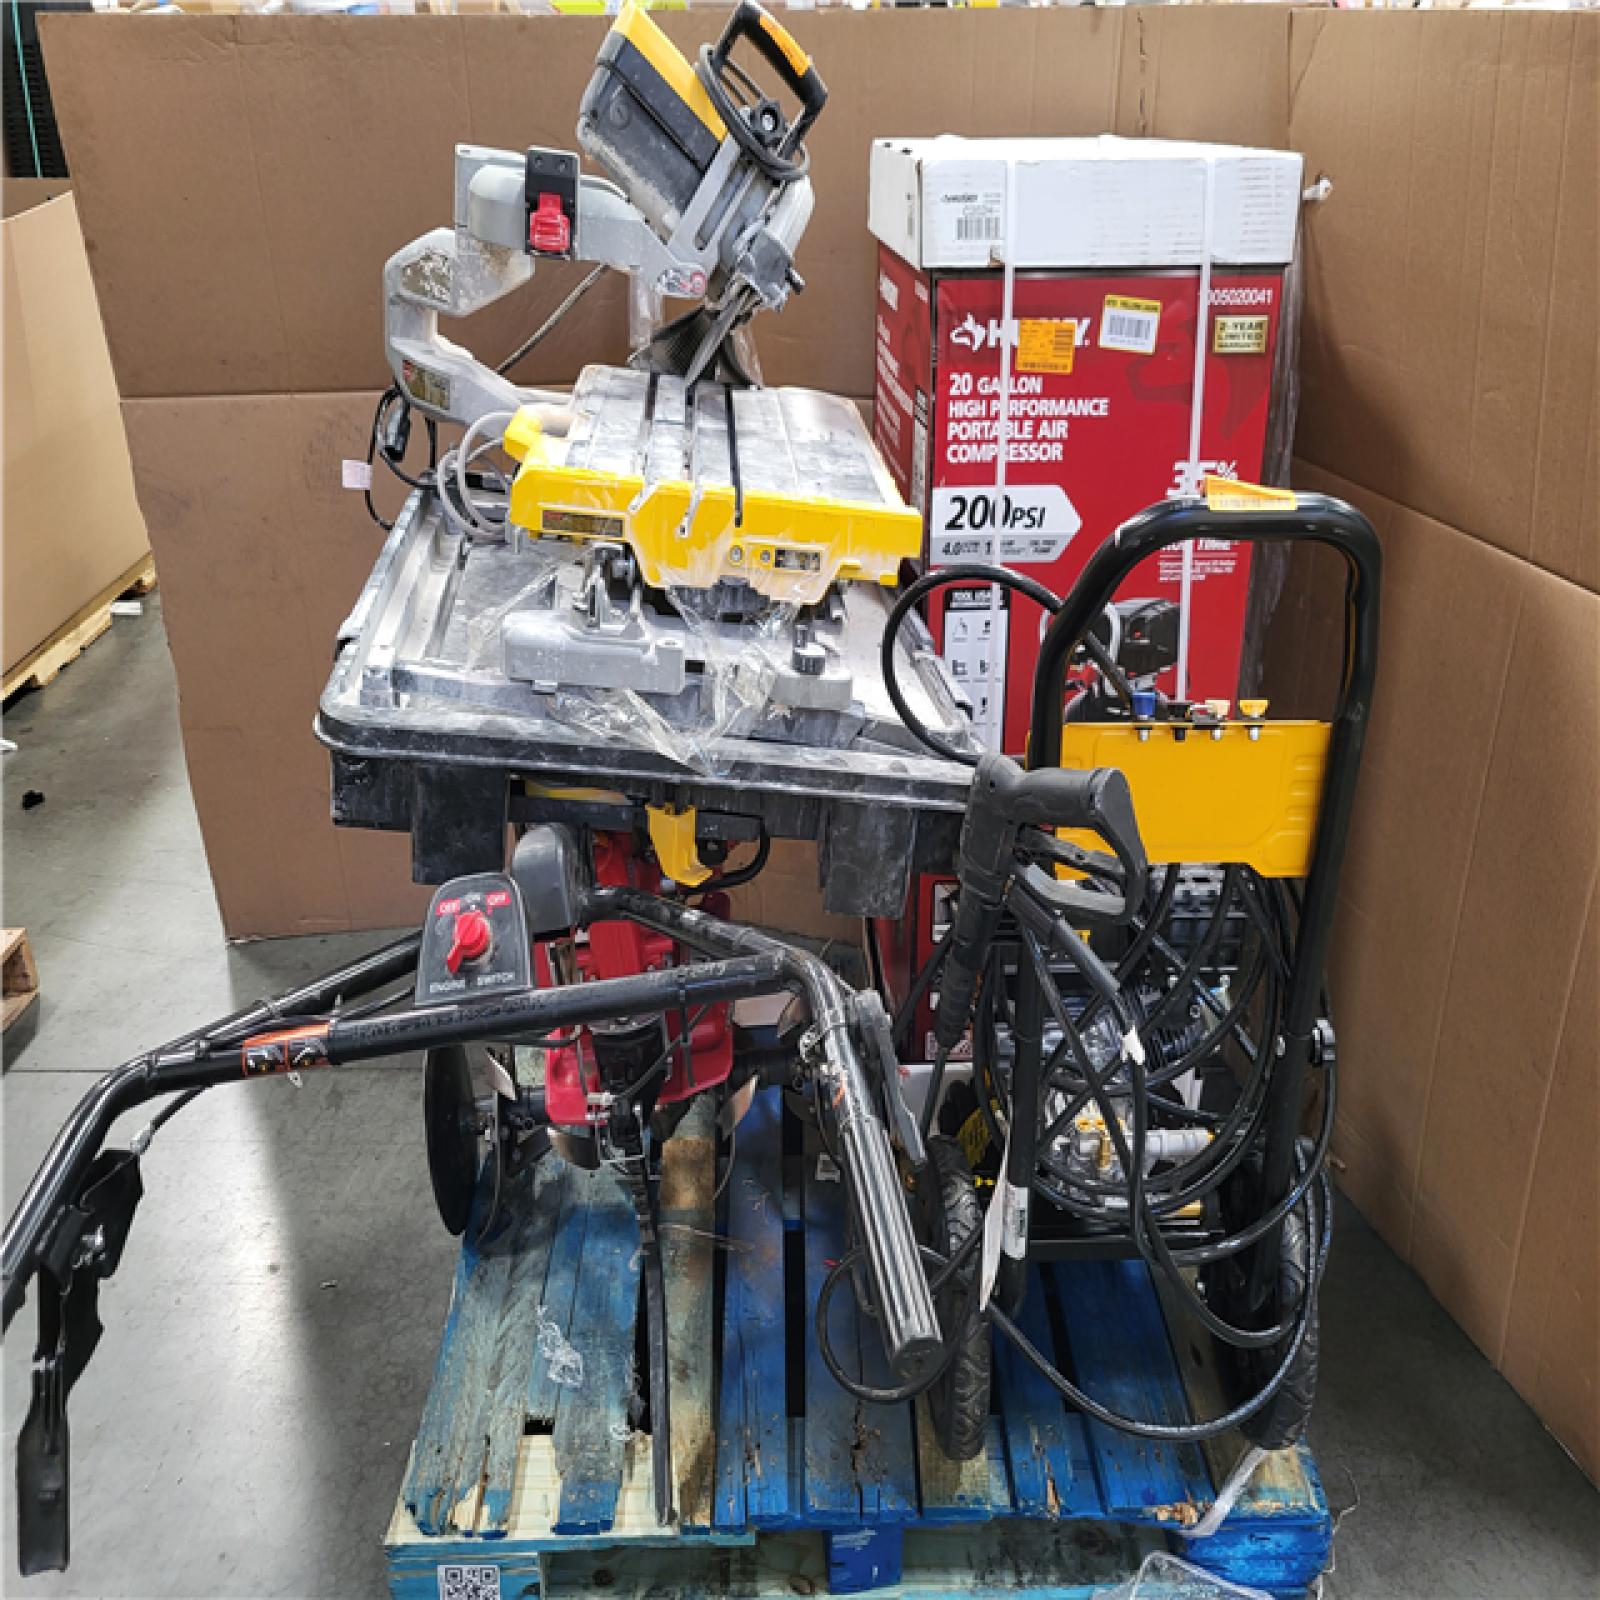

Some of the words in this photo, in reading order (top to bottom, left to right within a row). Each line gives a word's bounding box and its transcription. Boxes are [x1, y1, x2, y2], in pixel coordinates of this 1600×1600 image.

[949, 373, 973, 396] 20
[977, 376, 1043, 395] GALON
[949, 399, 986, 418] HIGH
[989, 398, 1110, 417] PRFORMANCE
[1038, 419, 1069, 439] AIR
[946, 443, 1064, 463] COMPESSOR
